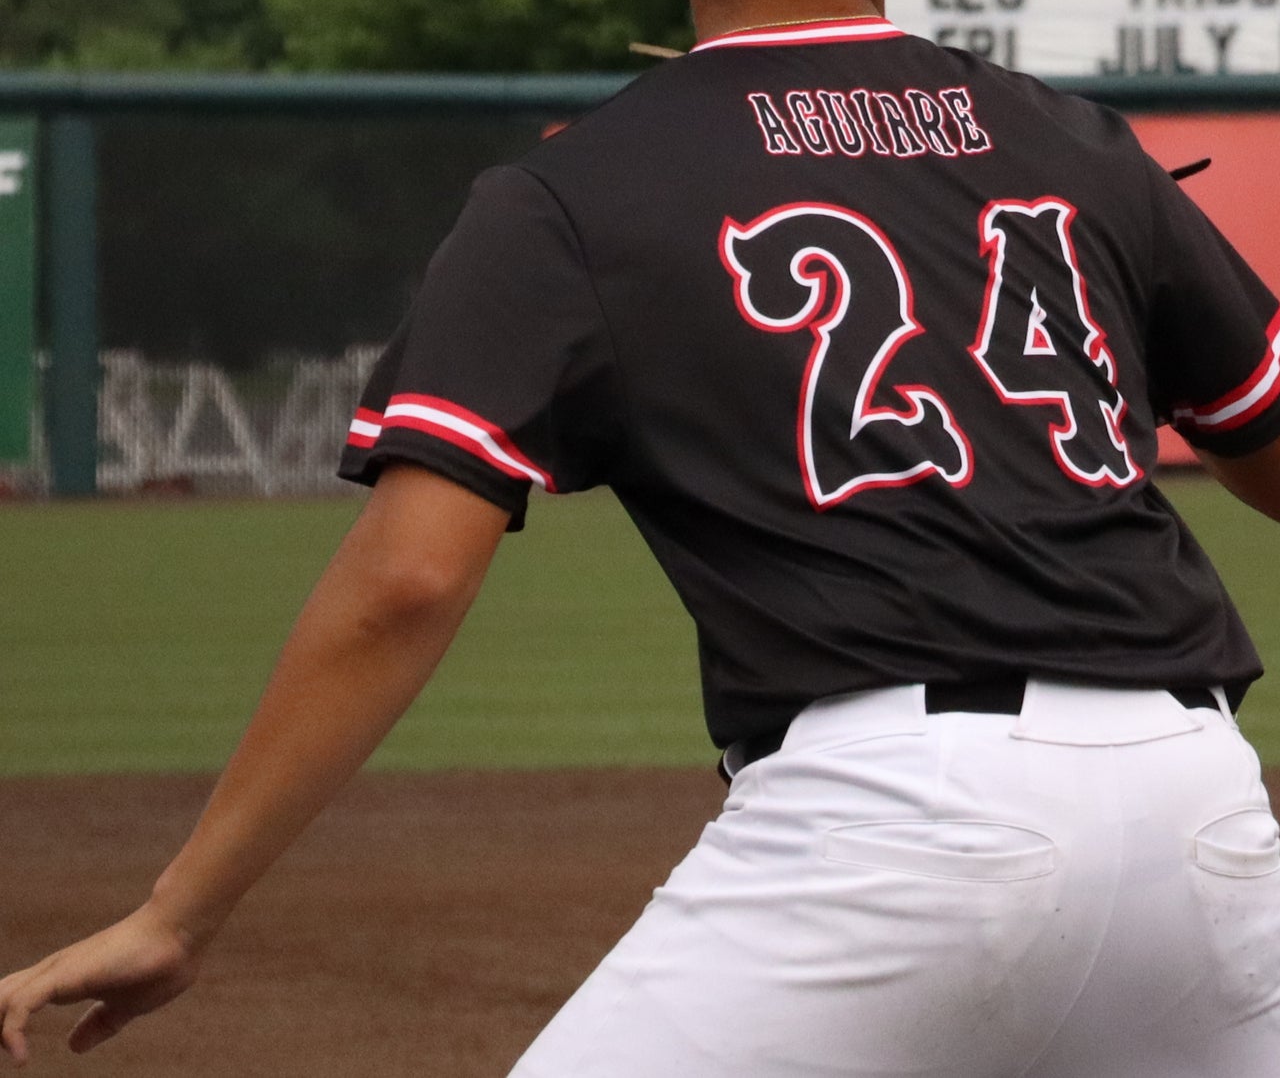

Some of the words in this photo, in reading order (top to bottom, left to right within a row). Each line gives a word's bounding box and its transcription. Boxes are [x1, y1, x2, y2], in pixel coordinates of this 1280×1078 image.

[1099, 24, 1236, 76] JULY
[748, 86, 992, 157] AGUIRRE
[718, 195, 1144, 511] 24
